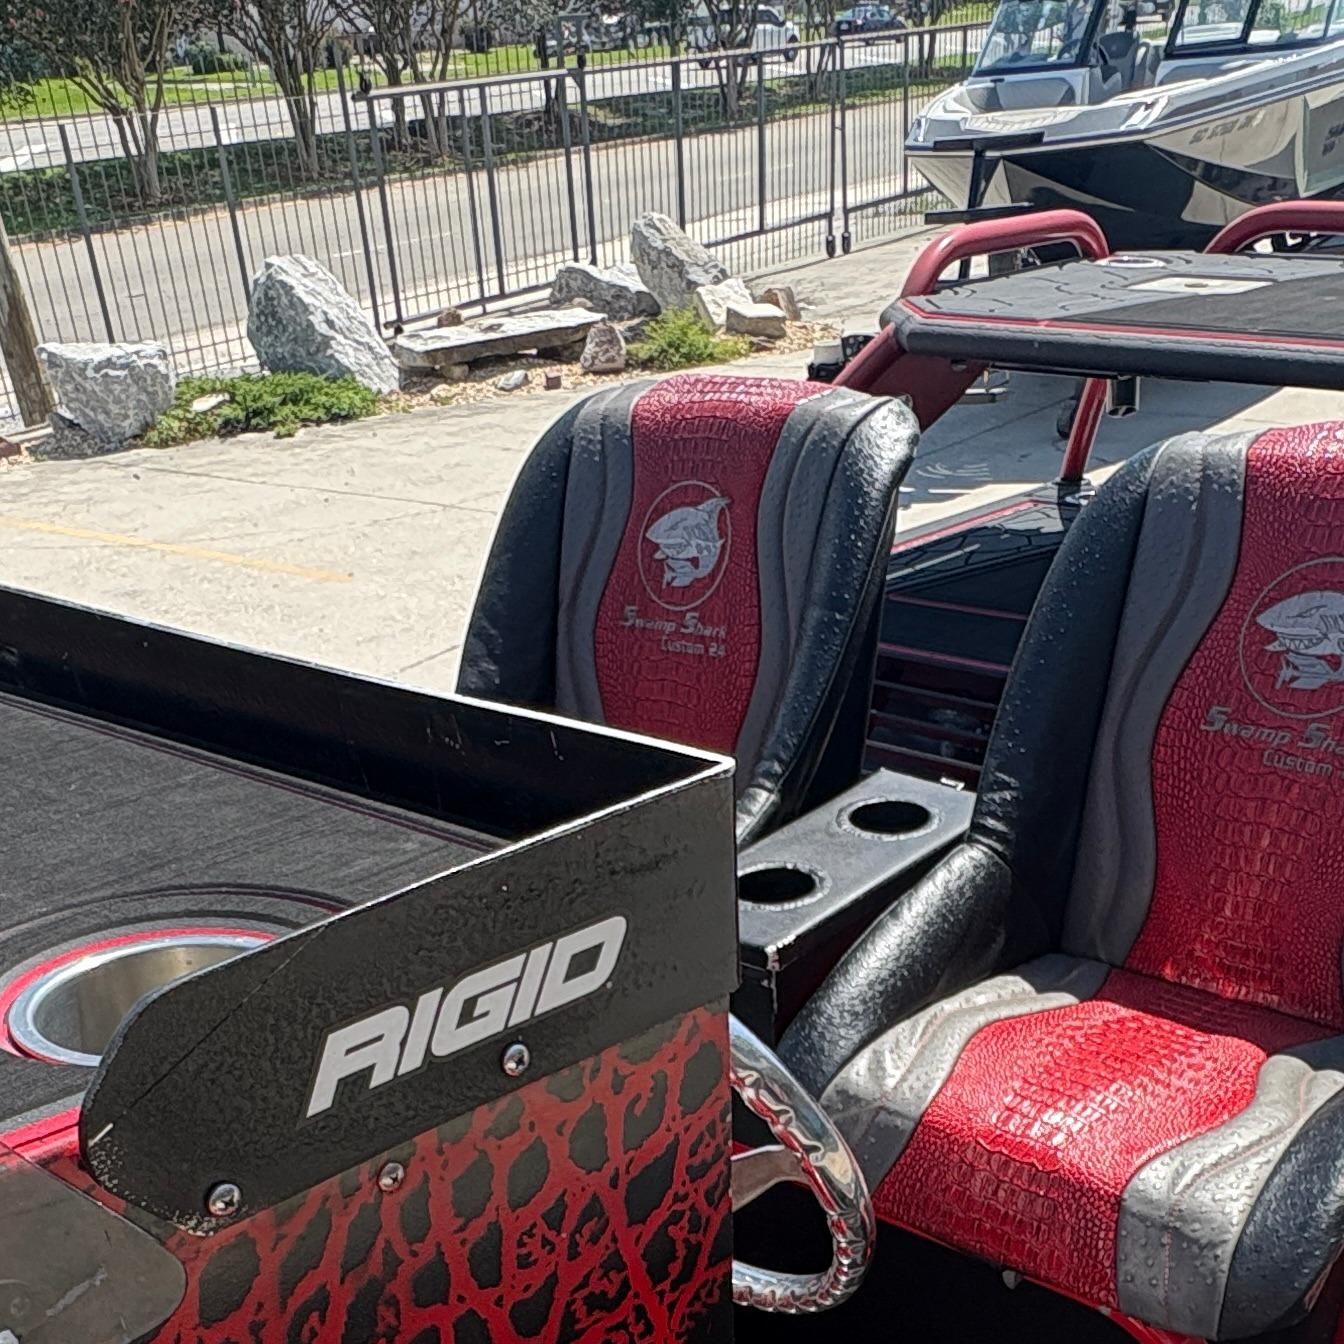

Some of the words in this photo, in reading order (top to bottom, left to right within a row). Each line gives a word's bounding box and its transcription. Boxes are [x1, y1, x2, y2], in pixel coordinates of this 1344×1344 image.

[620, 604, 677, 634] Swamp
[680, 611, 728, 639] Shark
[1199, 705, 1292, 747] Swamp
[1263, 749, 1333, 777] Custom
[306, 915, 628, 1119] RIGID
